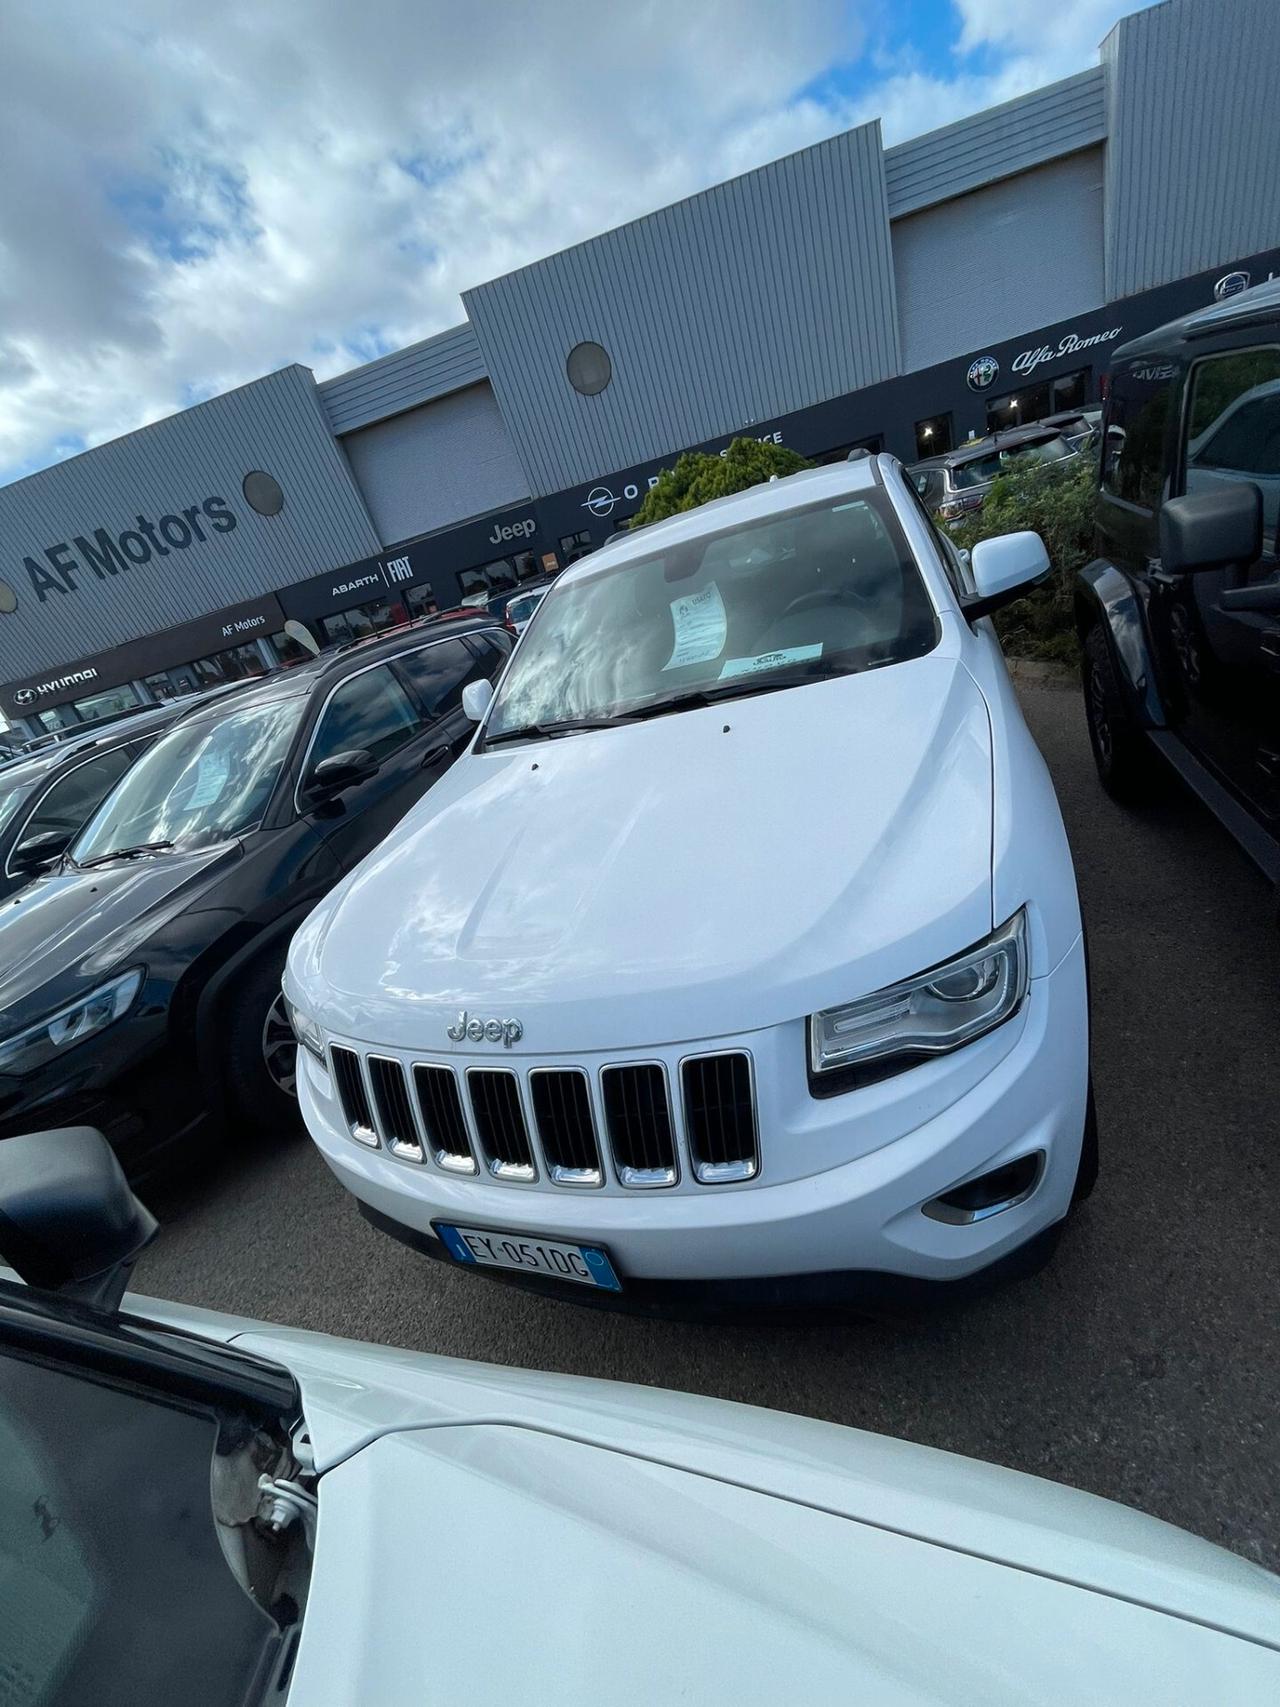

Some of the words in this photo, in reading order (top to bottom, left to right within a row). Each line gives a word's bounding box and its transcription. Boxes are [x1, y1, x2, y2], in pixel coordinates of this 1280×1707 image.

[1011, 344, 1056, 376] Alfa
[1055, 326, 1123, 358] Romeo
[489, 518, 536, 545] Jeep
[332, 573, 379, 596] ABARTH
[386, 556, 414, 583] FIAT
[221, 624, 233, 637] AF
[233, 615, 266, 632] Motors
[447, 1009, 524, 1049] Jeep
